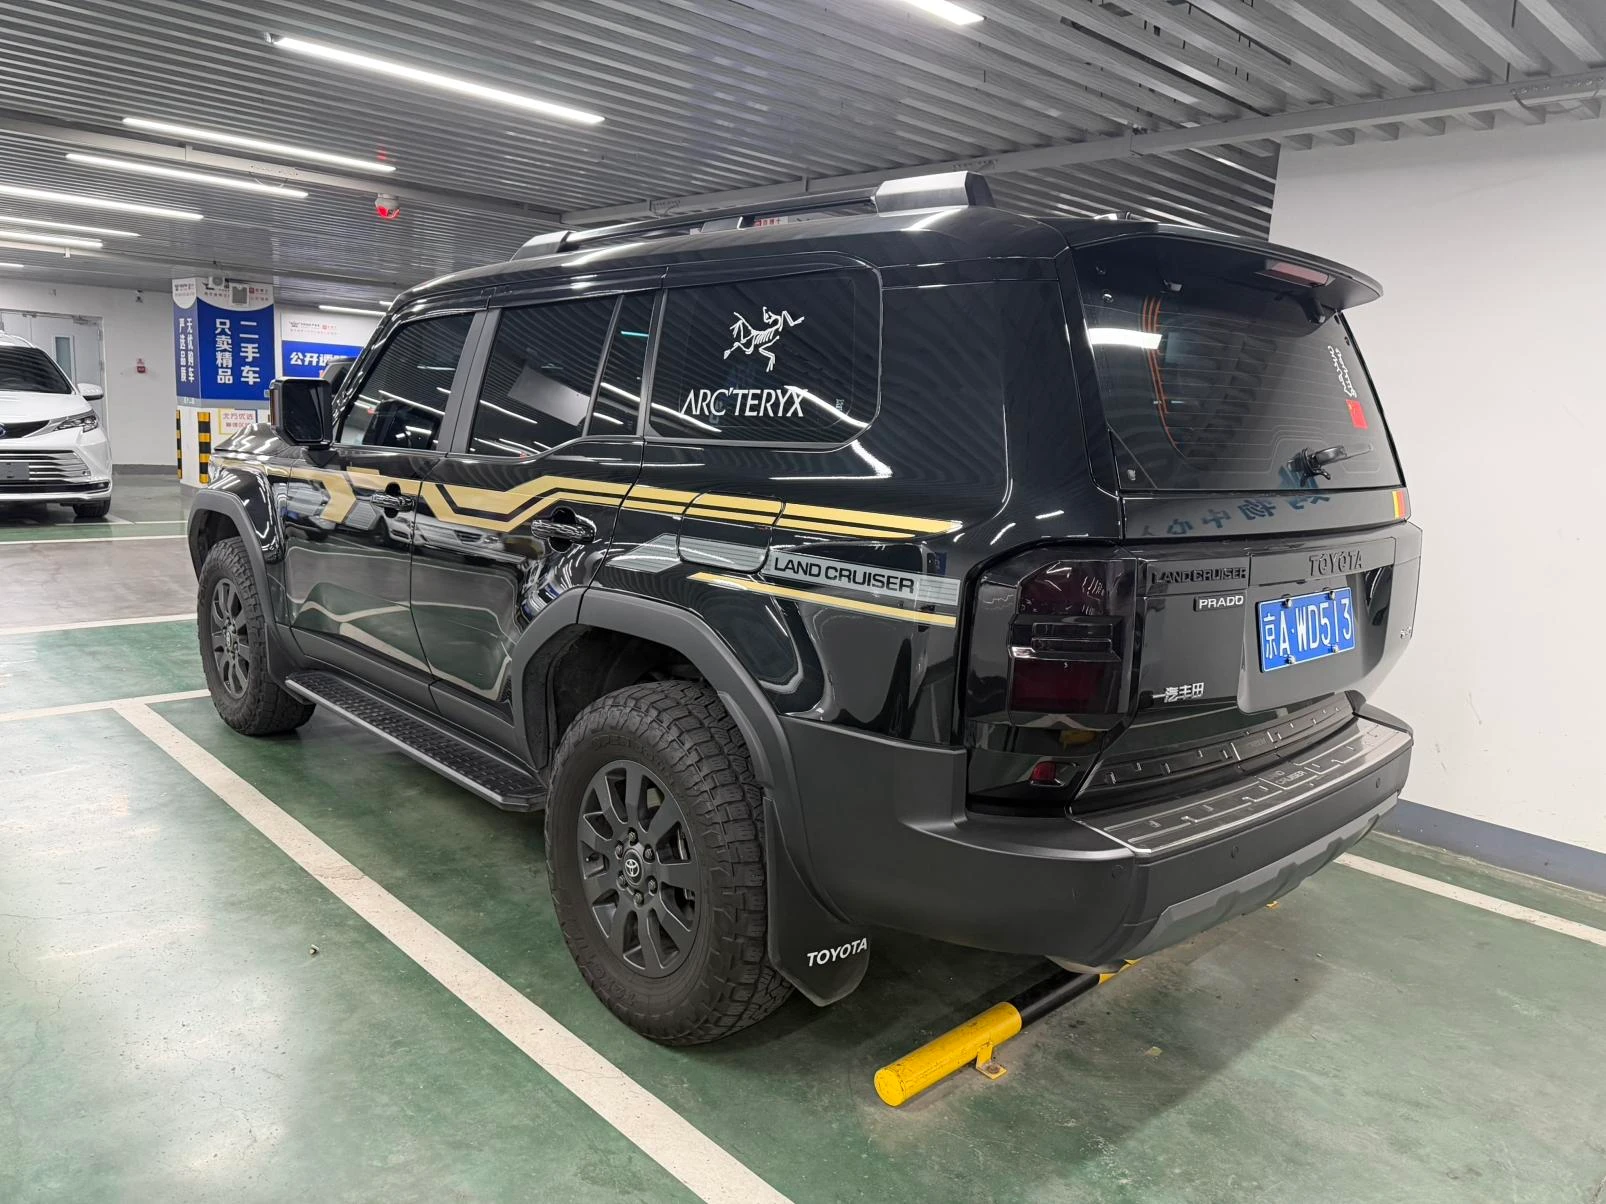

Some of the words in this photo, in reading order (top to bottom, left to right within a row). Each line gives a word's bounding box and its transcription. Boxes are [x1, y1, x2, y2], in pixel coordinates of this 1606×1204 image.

[214, 317, 234, 385] 只卖精品
[239, 320, 261, 386] 二手车
[774, 557, 822, 578] LAND
[824, 565, 914, 594] CRUISER
[1152, 571, 1190, 585] LAND
[1190, 566, 1247, 582] CRUISER
[1309, 550, 1363, 577] TOYOTA
[1199, 595, 1244, 609] PRADO
[1152, 682, 1204, 703] 一汽丰田
[807, 937, 868, 967] TOYOTA
